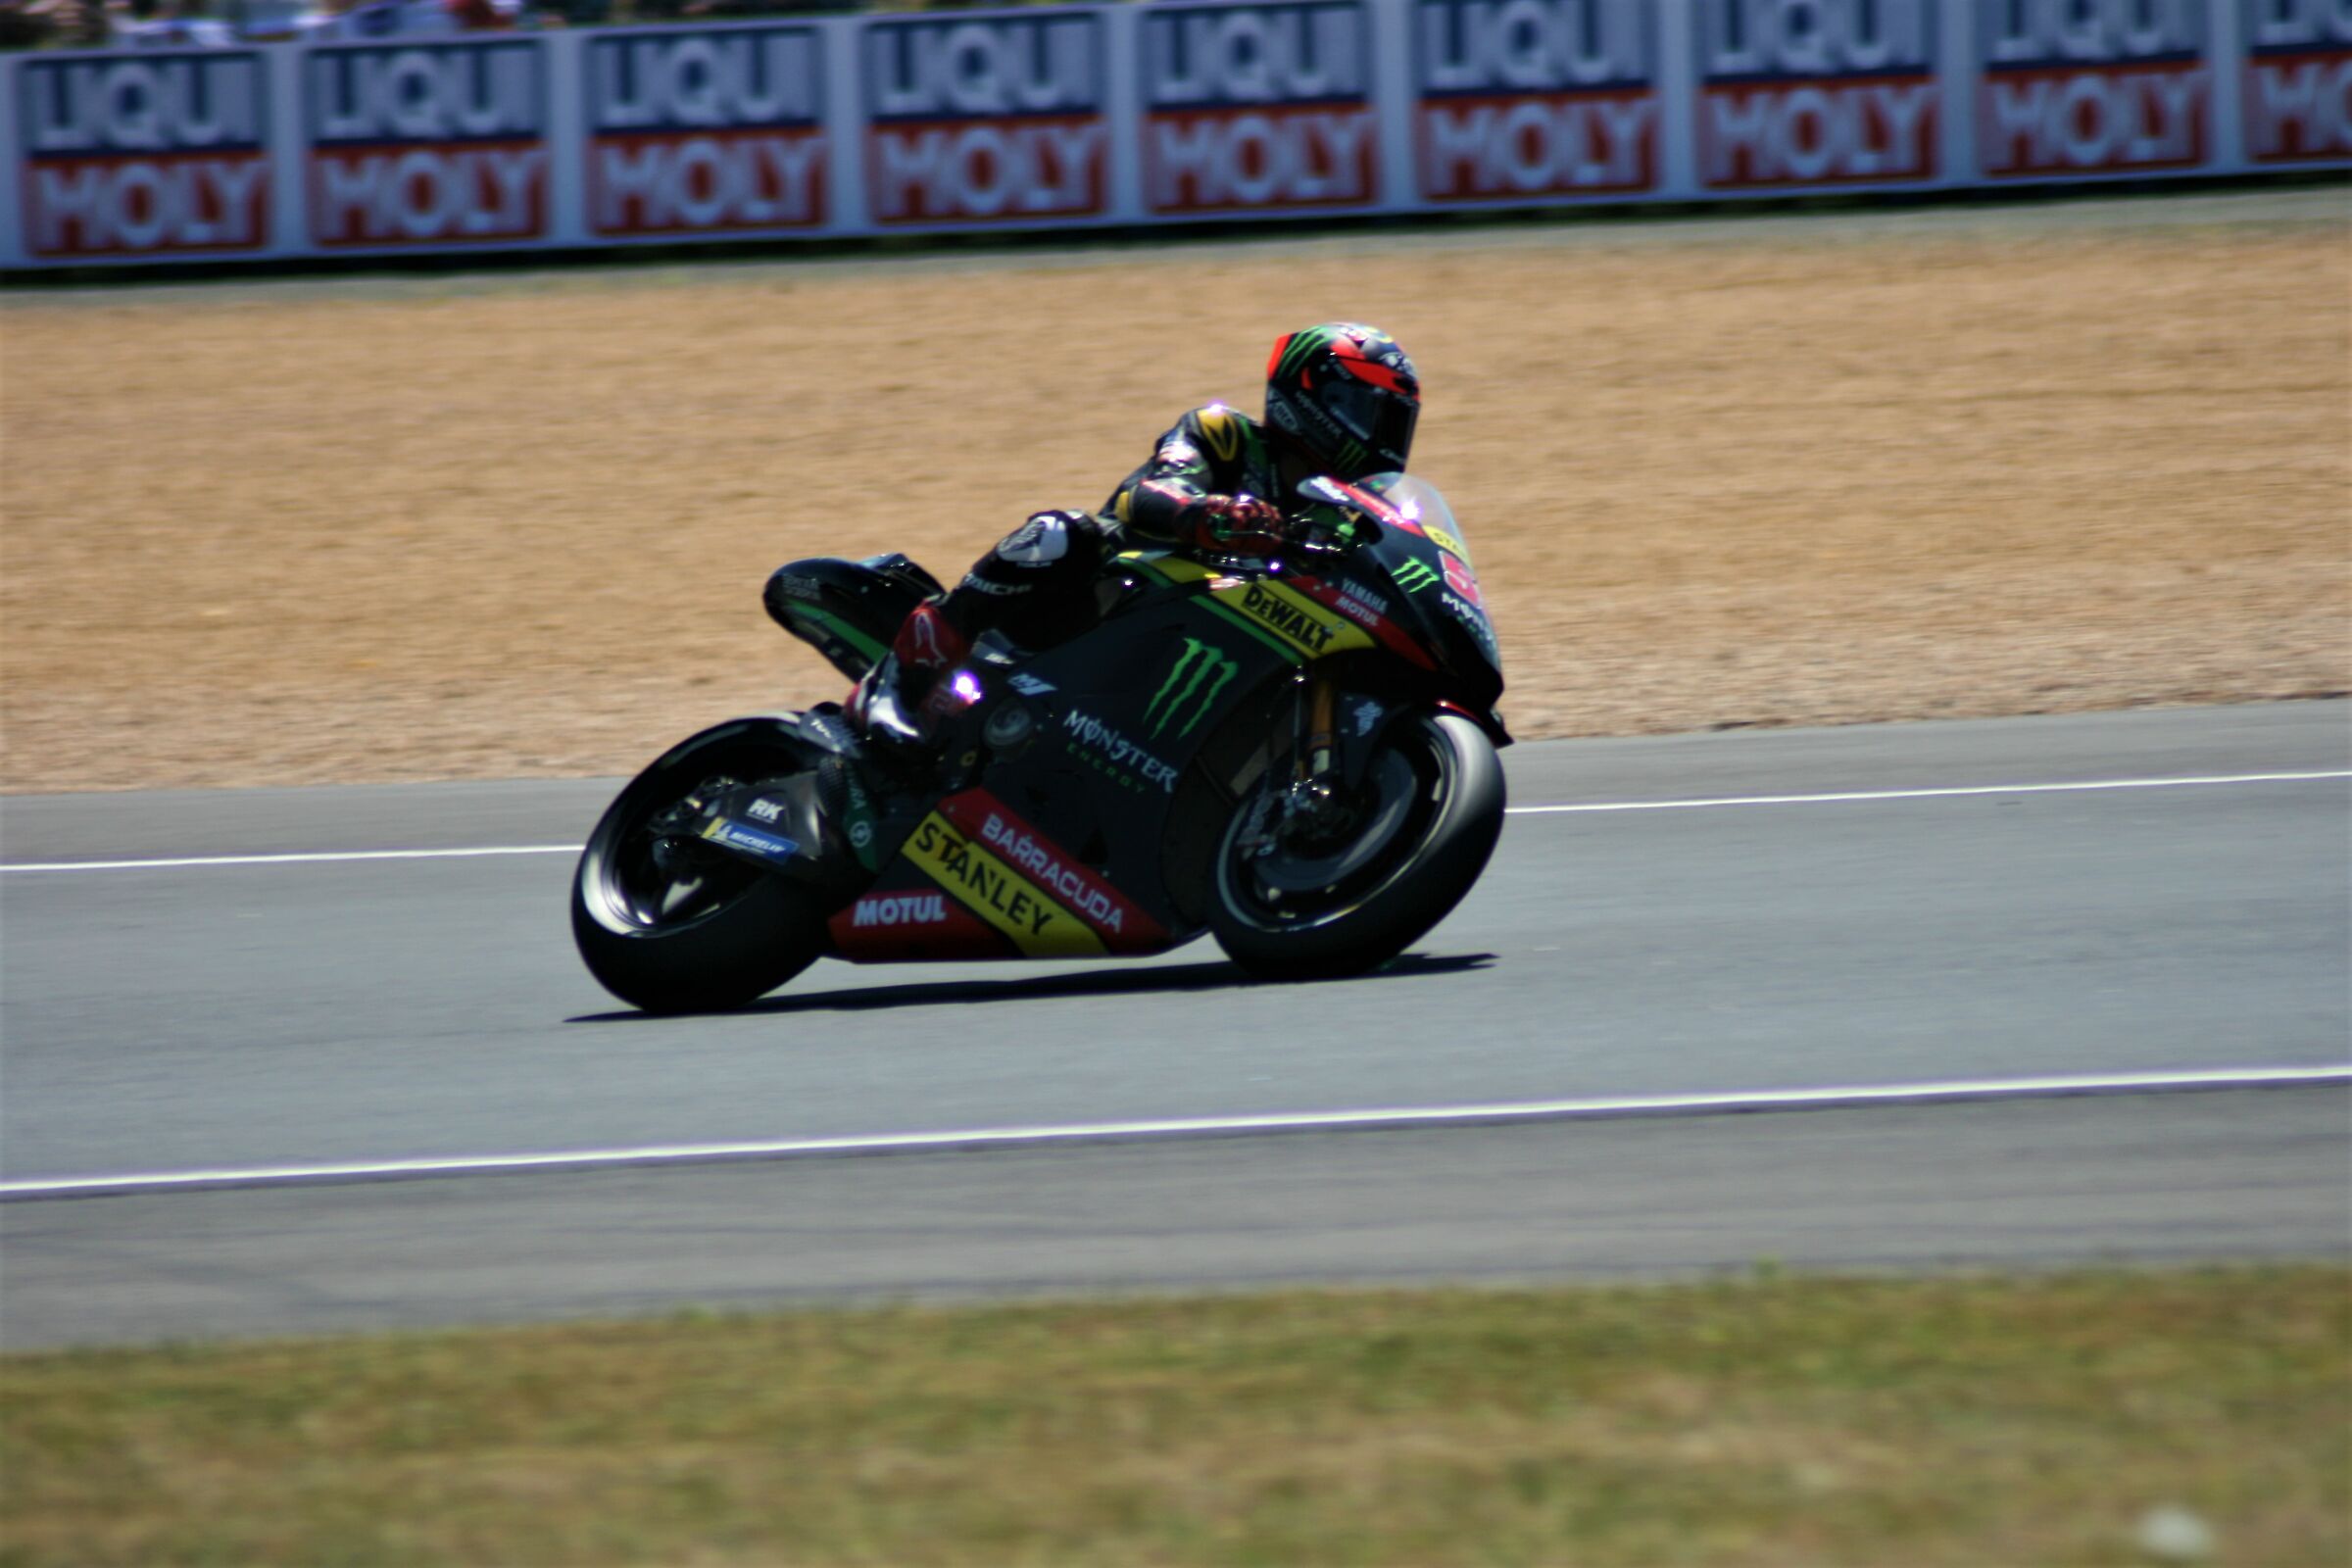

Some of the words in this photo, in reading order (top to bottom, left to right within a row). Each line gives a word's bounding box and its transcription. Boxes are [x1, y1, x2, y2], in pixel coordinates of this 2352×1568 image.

[1152, 113, 1375, 205] MOLY
[1432, 100, 1654, 192] MOLY
[1709, 85, 1932, 178] MOLY
[1987, 71, 2210, 171] MOLY
[40, 160, 263, 249] MOLY
[324, 148, 547, 238] MOLY
[602, 136, 824, 227] MOLY
[884, 124, 1106, 216] MOLY
[1335, 595, 1380, 627] MOTUL
[1340, 577, 1390, 615] YAMAHA
[1063, 710, 1179, 793] MONSTER
[729, 832, 786, 855] MICHELIN
[749, 797, 785, 819] RK
[853, 895, 948, 927] MOTUL
[915, 821, 1054, 938] STANLEY
[982, 812, 1124, 934] BARRACUDA
